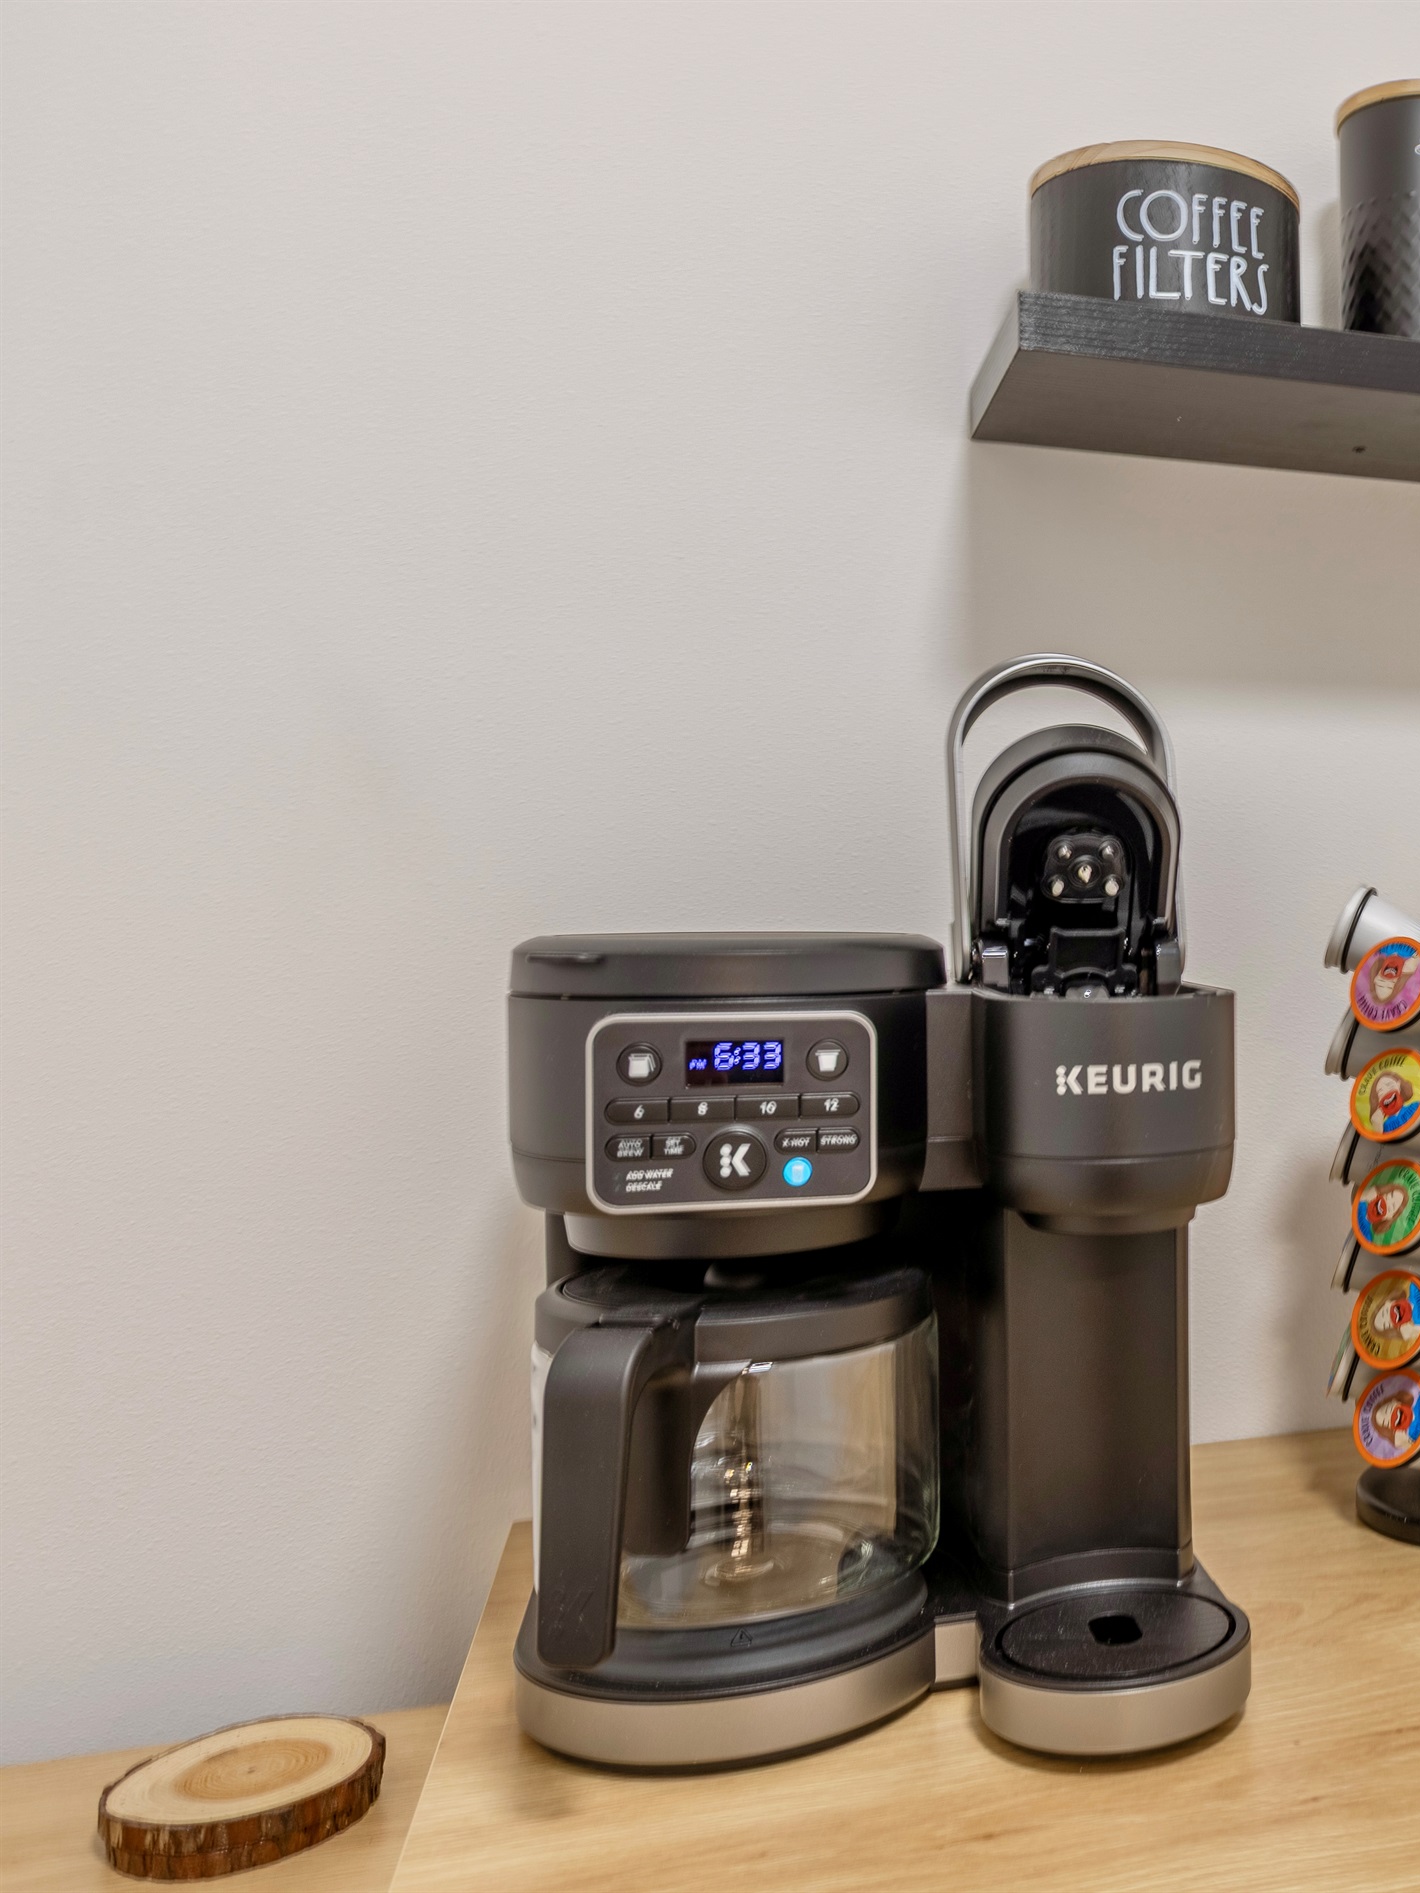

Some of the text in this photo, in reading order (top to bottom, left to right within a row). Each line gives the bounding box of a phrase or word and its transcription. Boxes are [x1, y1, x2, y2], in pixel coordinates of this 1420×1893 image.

[1116, 189, 1265, 260] COFFEE
[1113, 245, 1269, 316] FILTERS
[713, 1041, 783, 1072] 6:33
[1056, 1060, 1202, 1096] KEURIG
[824, 1098, 840, 1112] 12
[633, 1105, 645, 1119] 6
[618, 1139, 643, 1149] AUTO
[820, 1134, 857, 1146] STRONG
[617, 1147, 645, 1158] BREW
[664, 1145, 685, 1155] TIME
[626, 1168, 674, 1181] ADD WATER
[626, 1181, 662, 1192] DESCALE
